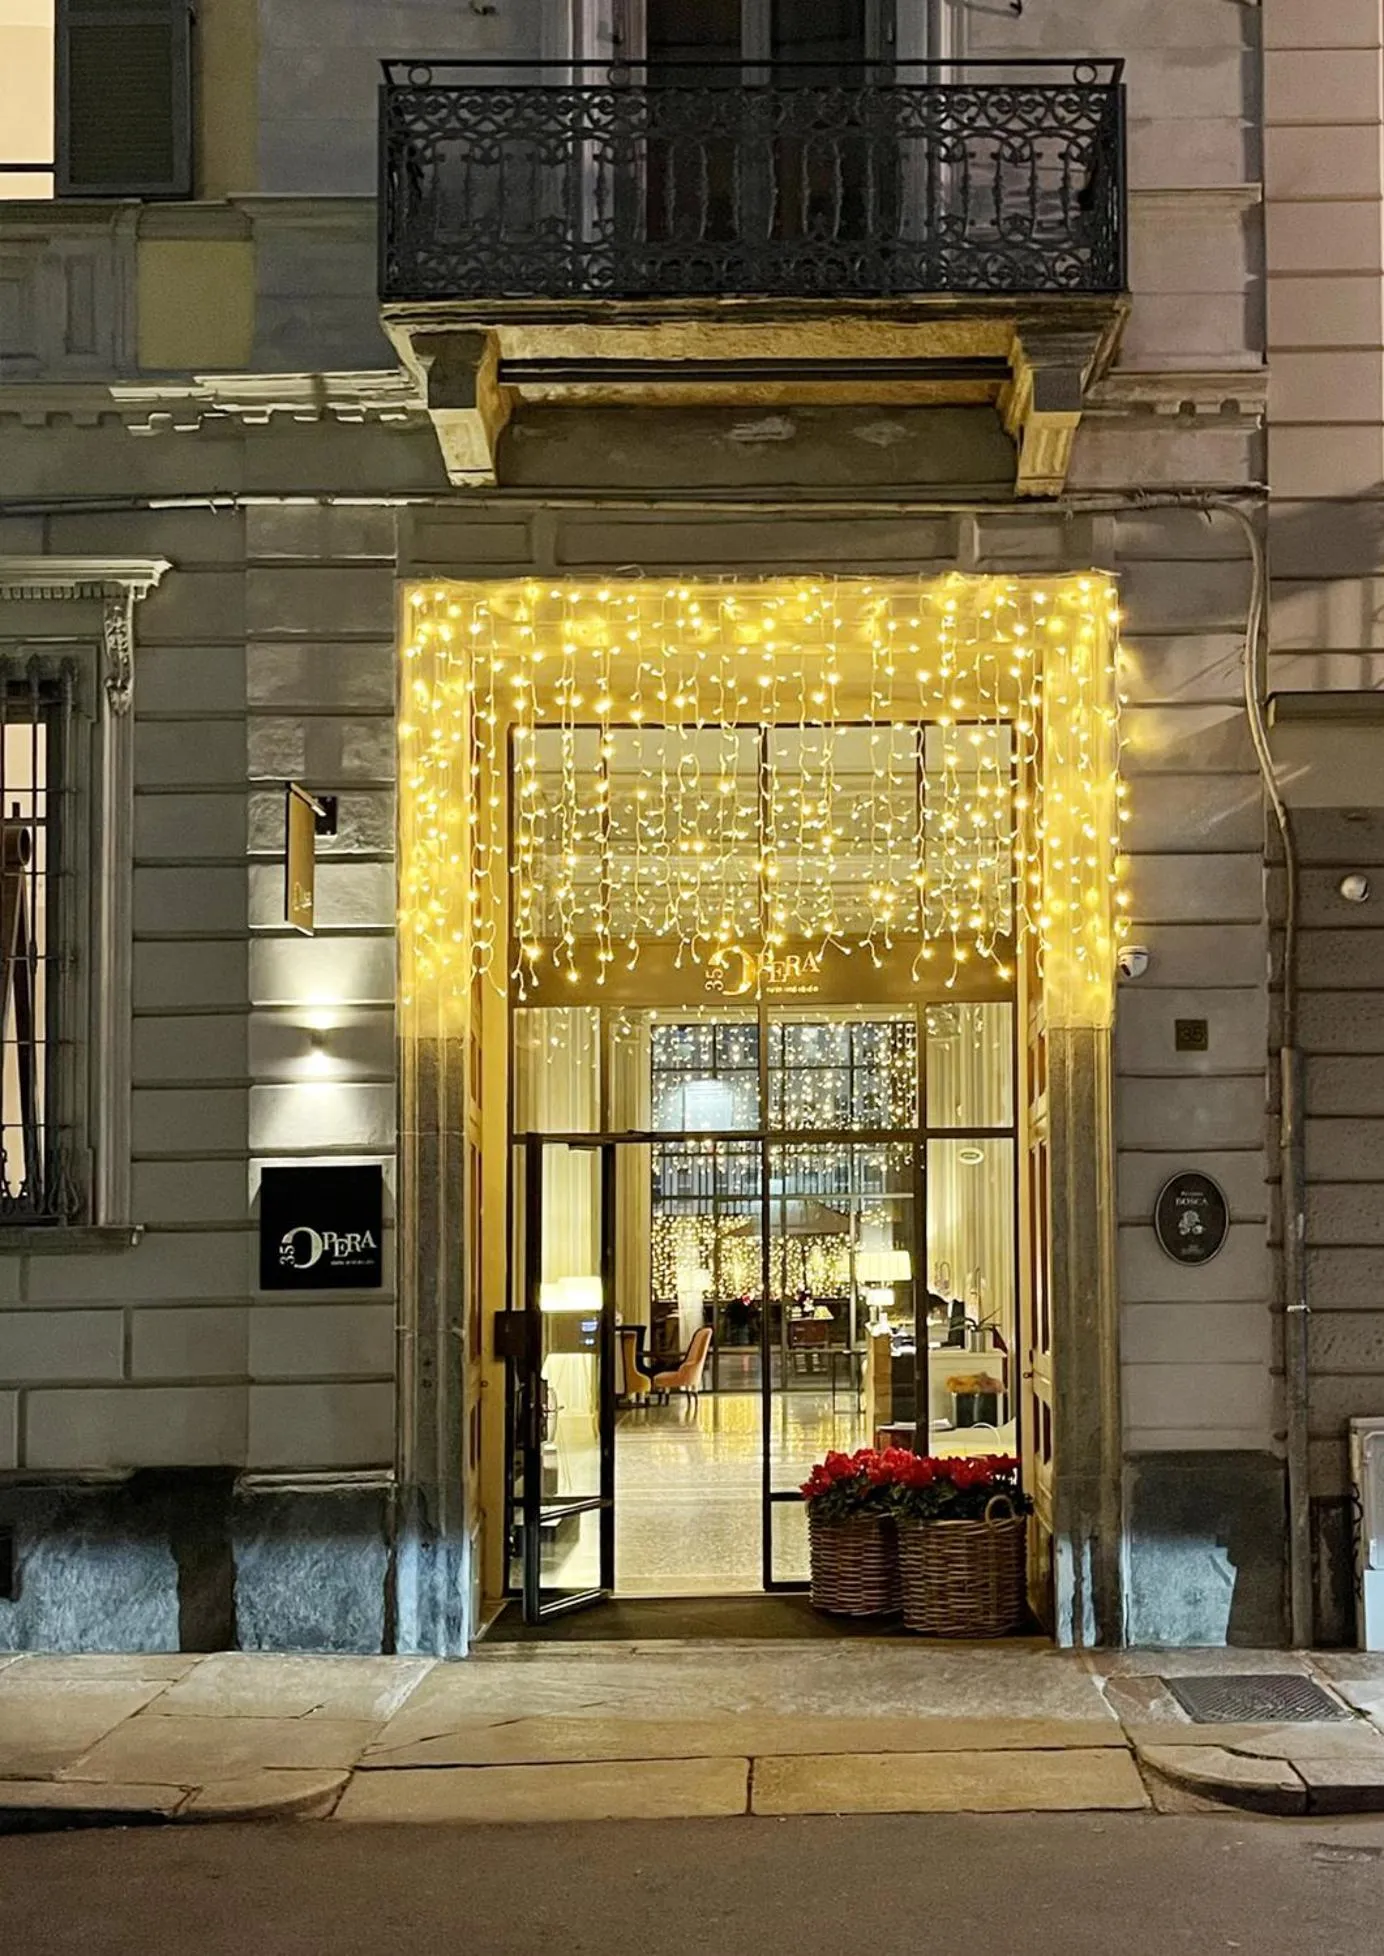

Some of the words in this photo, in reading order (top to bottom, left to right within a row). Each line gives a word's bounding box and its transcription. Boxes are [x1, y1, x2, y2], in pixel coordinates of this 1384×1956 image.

[704, 968, 724, 991] 35
[707, 945, 820, 996] OPERA
[1179, 1025, 1205, 1043] 35
[279, 1245, 295, 1265] 35
[281, 1226, 377, 1270] OPERA
